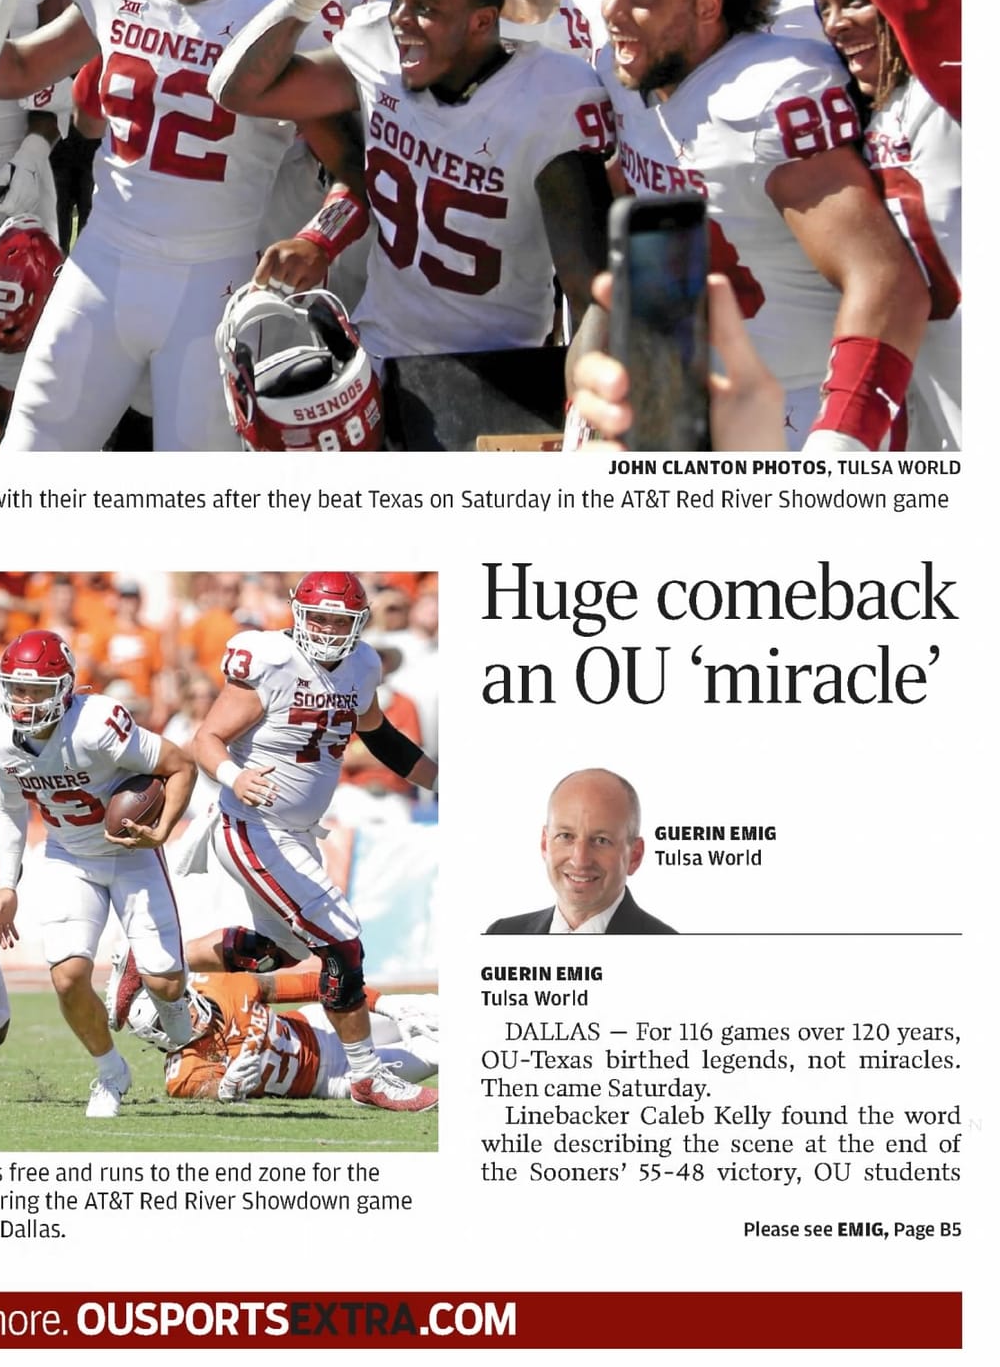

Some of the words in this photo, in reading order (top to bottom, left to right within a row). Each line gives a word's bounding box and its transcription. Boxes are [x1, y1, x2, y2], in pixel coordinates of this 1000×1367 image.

[109, 18, 225, 68] SOONER
[101, 51, 237, 183] 92
[774, 86, 862, 160] 88
[369, 110, 505, 193] SOONERS
[365, 145, 509, 296] 95
[293, 379, 363, 422] SOONERS
[608, 460, 657, 475] JOHN
[662, 460, 747, 475] CLANTON
[752, 460, 832, 477] PHOTOS,
[837, 460, 893, 475] TULSA
[897, 460, 961, 475] WORLD
[481, 562, 638, 638] Huge
[657, 560, 960, 621] comeback
[222, 647, 253, 680] 73
[482, 663, 556, 705] an
[575, 646, 671, 705] OU
[691, 644, 940, 705] ‘miracle’
[293, 691, 359, 710] SOONERS
[287, 707, 358, 764] 73
[654, 825, 725, 841] GUERIN
[730, 825, 777, 841] EMIG
[654, 849, 703, 866] Tulsa
[707, 849, 762, 866] World
[480, 966, 552, 981] GUERIN
[556, 966, 603, 981] EMIG
[480, 989, 529, 1006] Tulsa
[534, 989, 588, 1006] World
[480, 1077, 539, 1097] Then
[544, 1083, 602, 1097] came
[608, 1077, 711, 1103] Saturday.
[0, 1218, 66, 1239] Dallas.
[744, 1220, 800, 1237] Please
[804, 1224, 833, 1237] see
[837, 1222, 889, 1240] EMIG,
[894, 1222, 935, 1241] Page
[940, 1222, 962, 1237] B5
[76, 1301, 517, 1337] OUSPORTSEXTRA.COM
